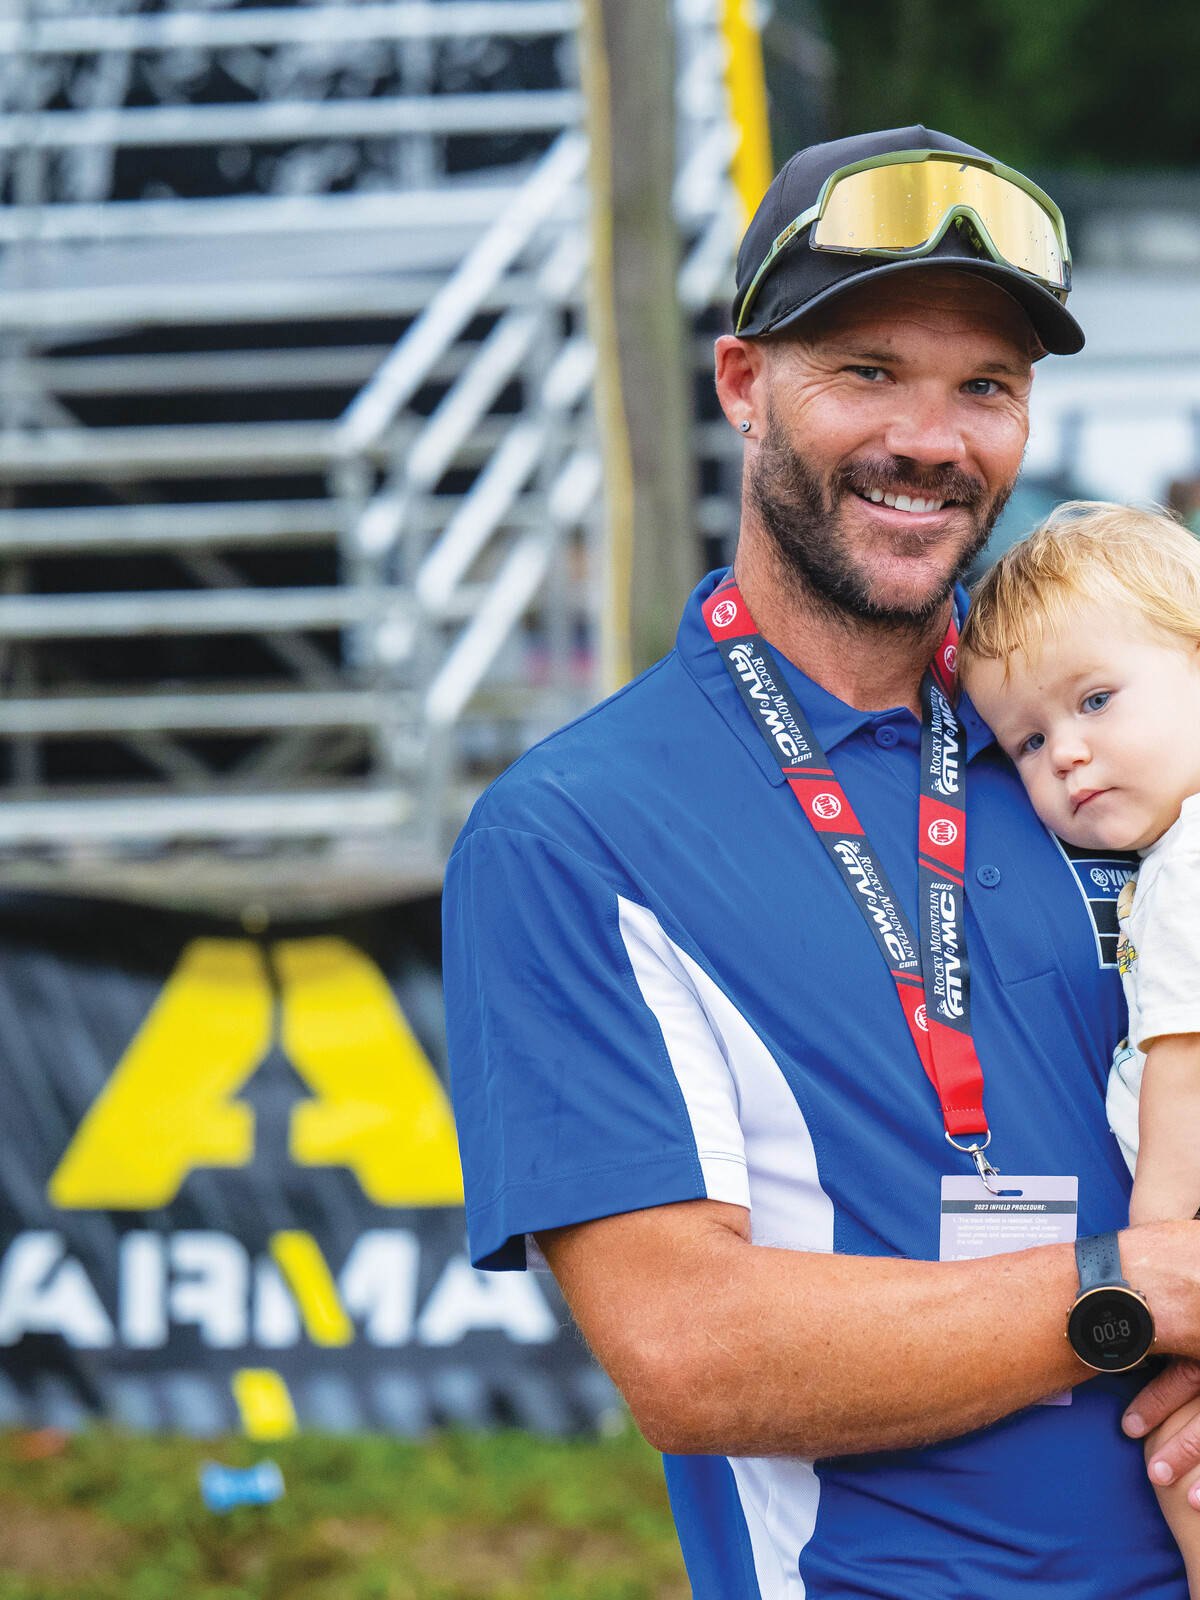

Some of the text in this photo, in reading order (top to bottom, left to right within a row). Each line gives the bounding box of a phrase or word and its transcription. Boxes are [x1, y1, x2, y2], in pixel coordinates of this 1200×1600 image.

[751, 656, 811, 752] ROCKY MOUNTAIN
[930, 736, 942, 775] ROCKY
[858, 855, 917, 959] ROCKY MOUNTAIN
[930, 890, 945, 997] ROCKY MOUNTAIN
